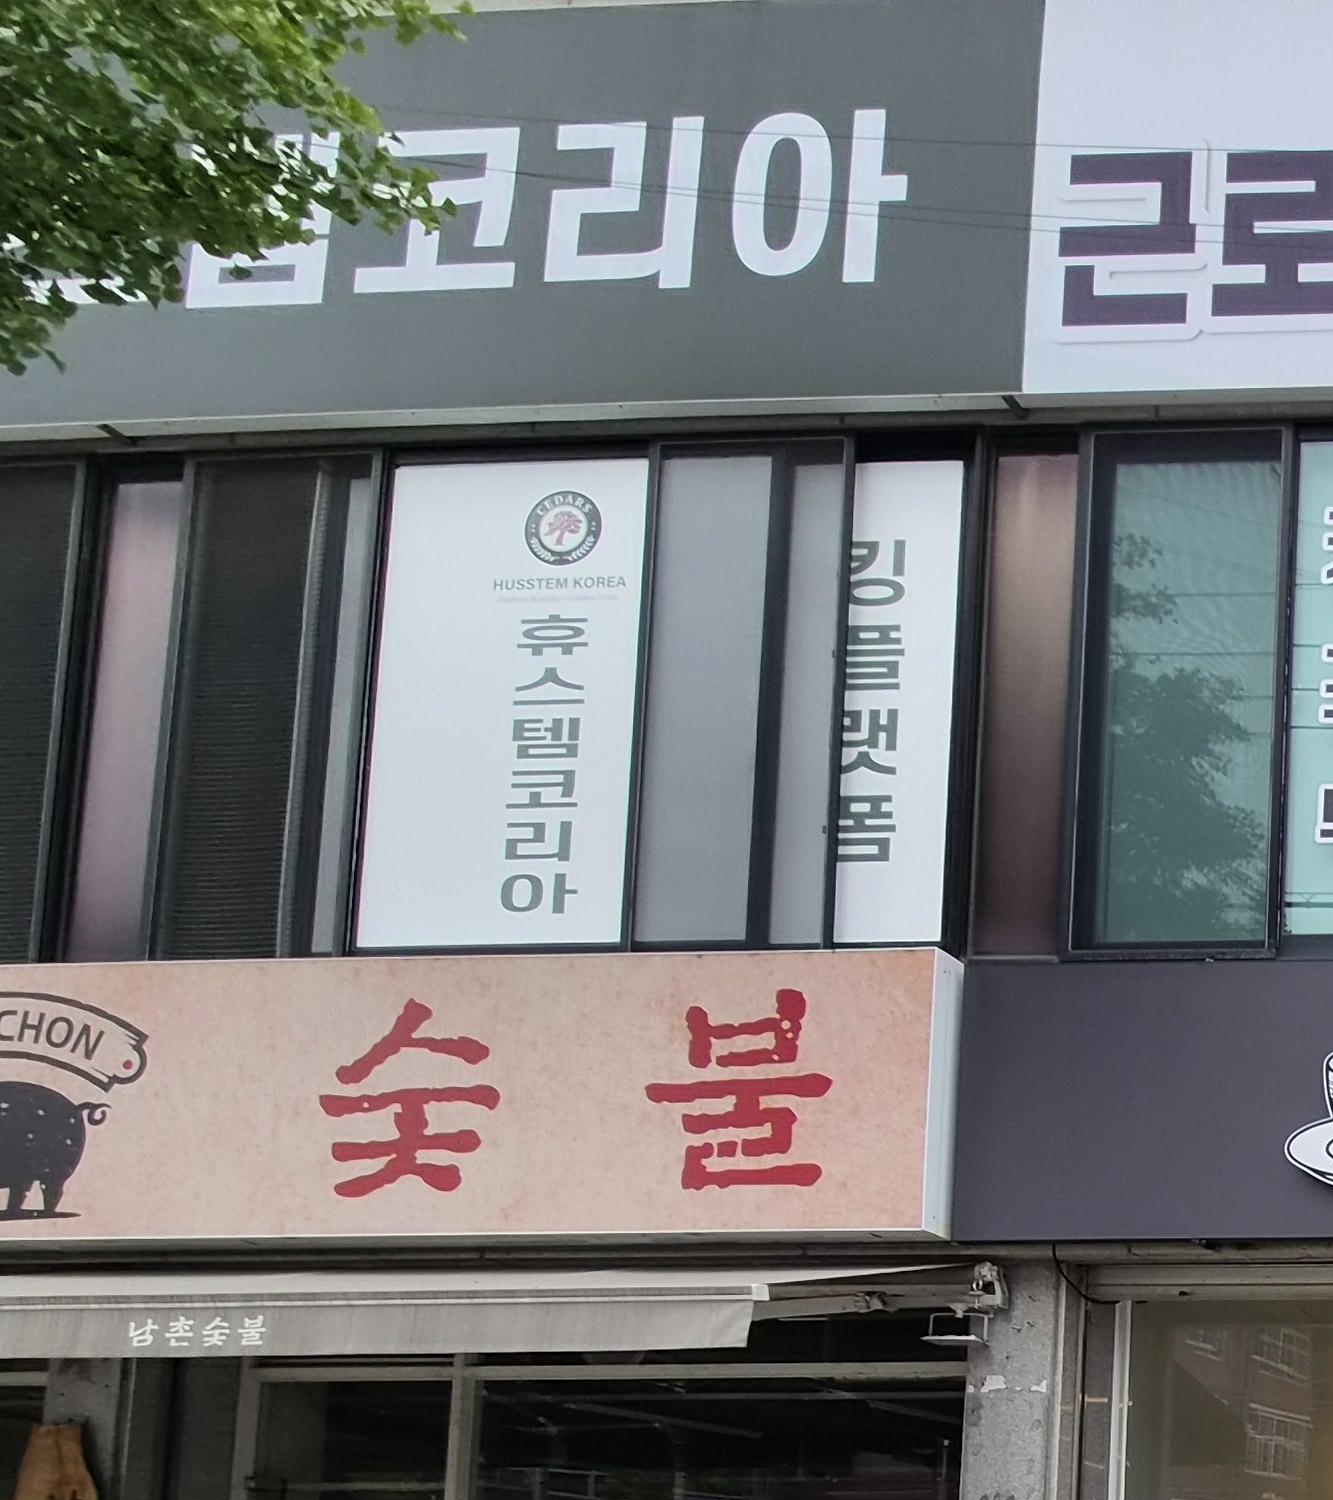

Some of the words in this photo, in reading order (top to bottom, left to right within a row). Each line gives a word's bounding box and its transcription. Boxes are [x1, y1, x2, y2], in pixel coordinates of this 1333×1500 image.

[493, 577, 568, 592] HUSSTEM
[573, 576, 627, 590] KOREA
[499, 613, 590, 915] 휴스템코리아
[836, 538, 907, 864] 킹플랫폼
[127, 1315, 268, 1348] 남촌숯불
